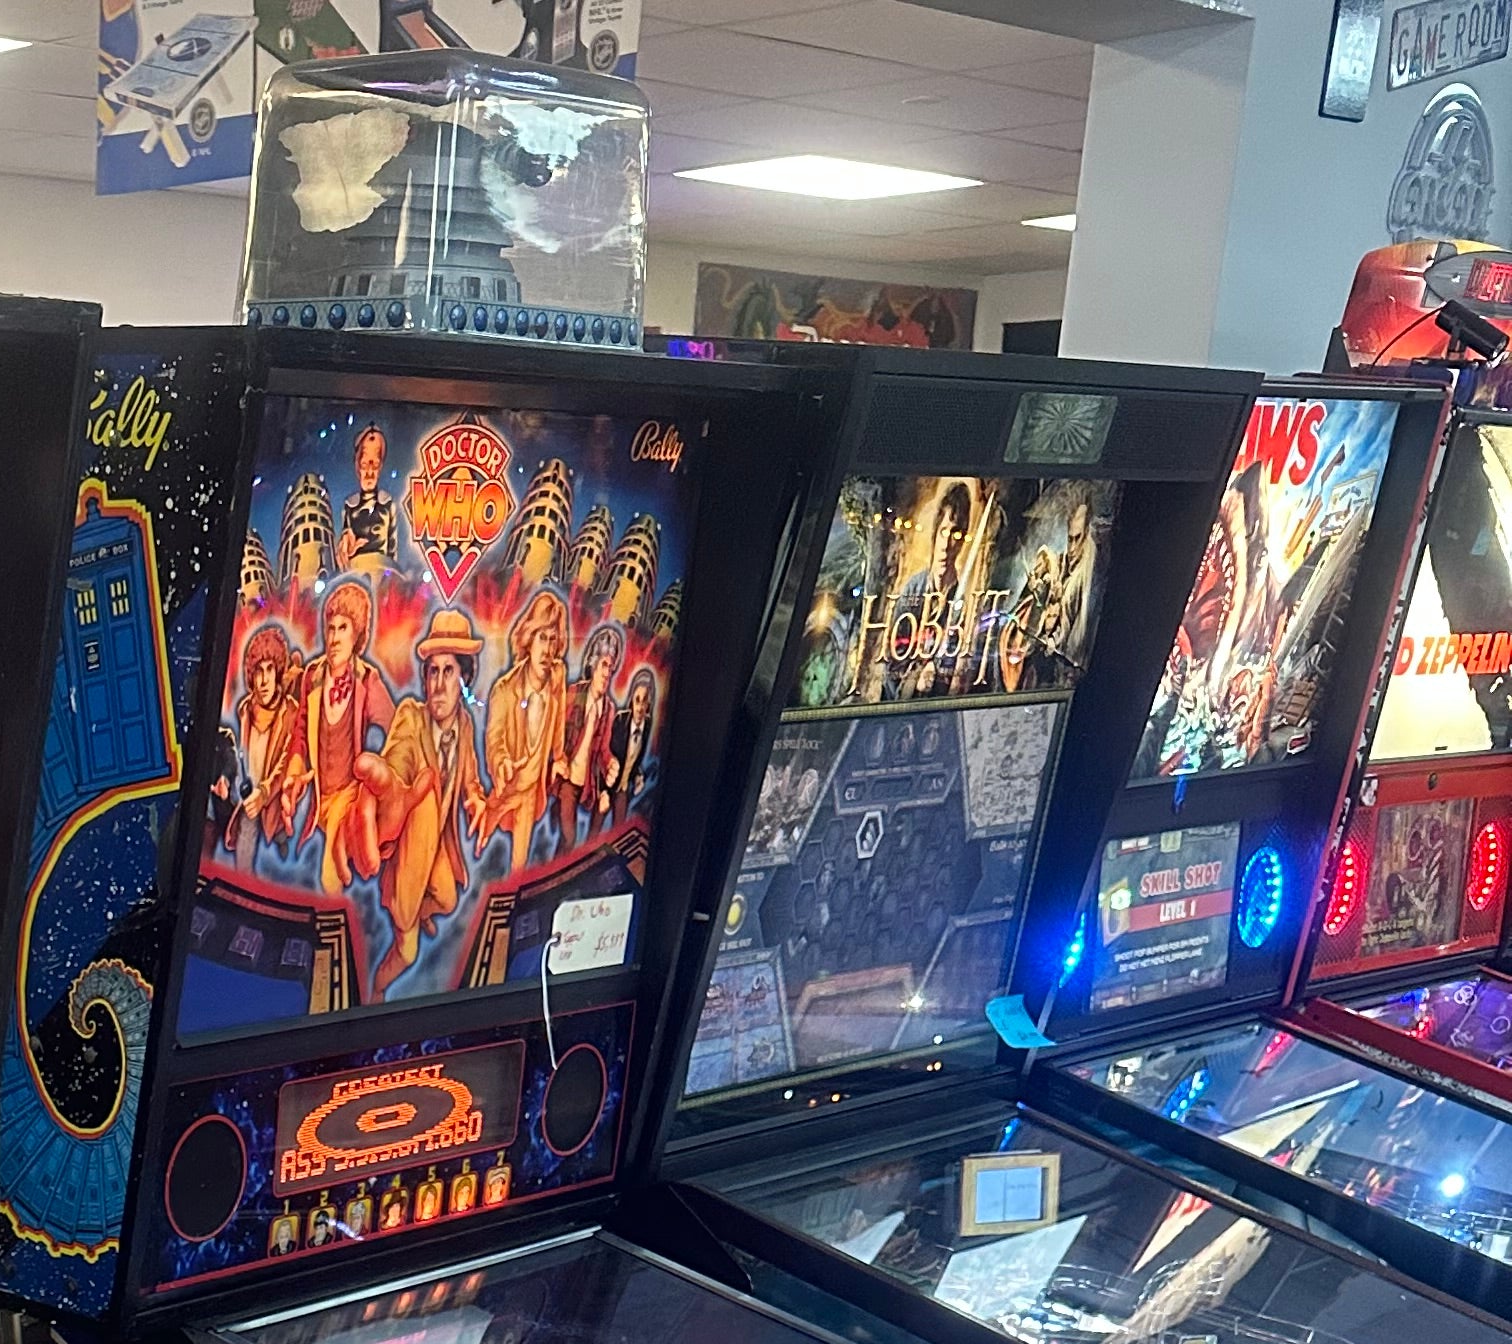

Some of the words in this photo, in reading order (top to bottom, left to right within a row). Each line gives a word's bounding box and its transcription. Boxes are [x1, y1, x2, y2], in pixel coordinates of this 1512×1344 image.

[1396, 14, 1451, 77] GAME
[86, 374, 173, 472] ally
[631, 420, 684, 475] Bally
[428, 430, 506, 478] DOCTOR
[412, 478, 512, 545] WHO
[69, 551, 97, 568] POLICE
[112, 543, 129, 556] BOX
[848, 589, 1010, 697] HOBBIT
[1140, 868, 1182, 898] SKILL
[1184, 861, 1222, 889] SHOT
[1159, 900, 1186, 922] LEVEL
[1190, 899, 1197, 917] 1
